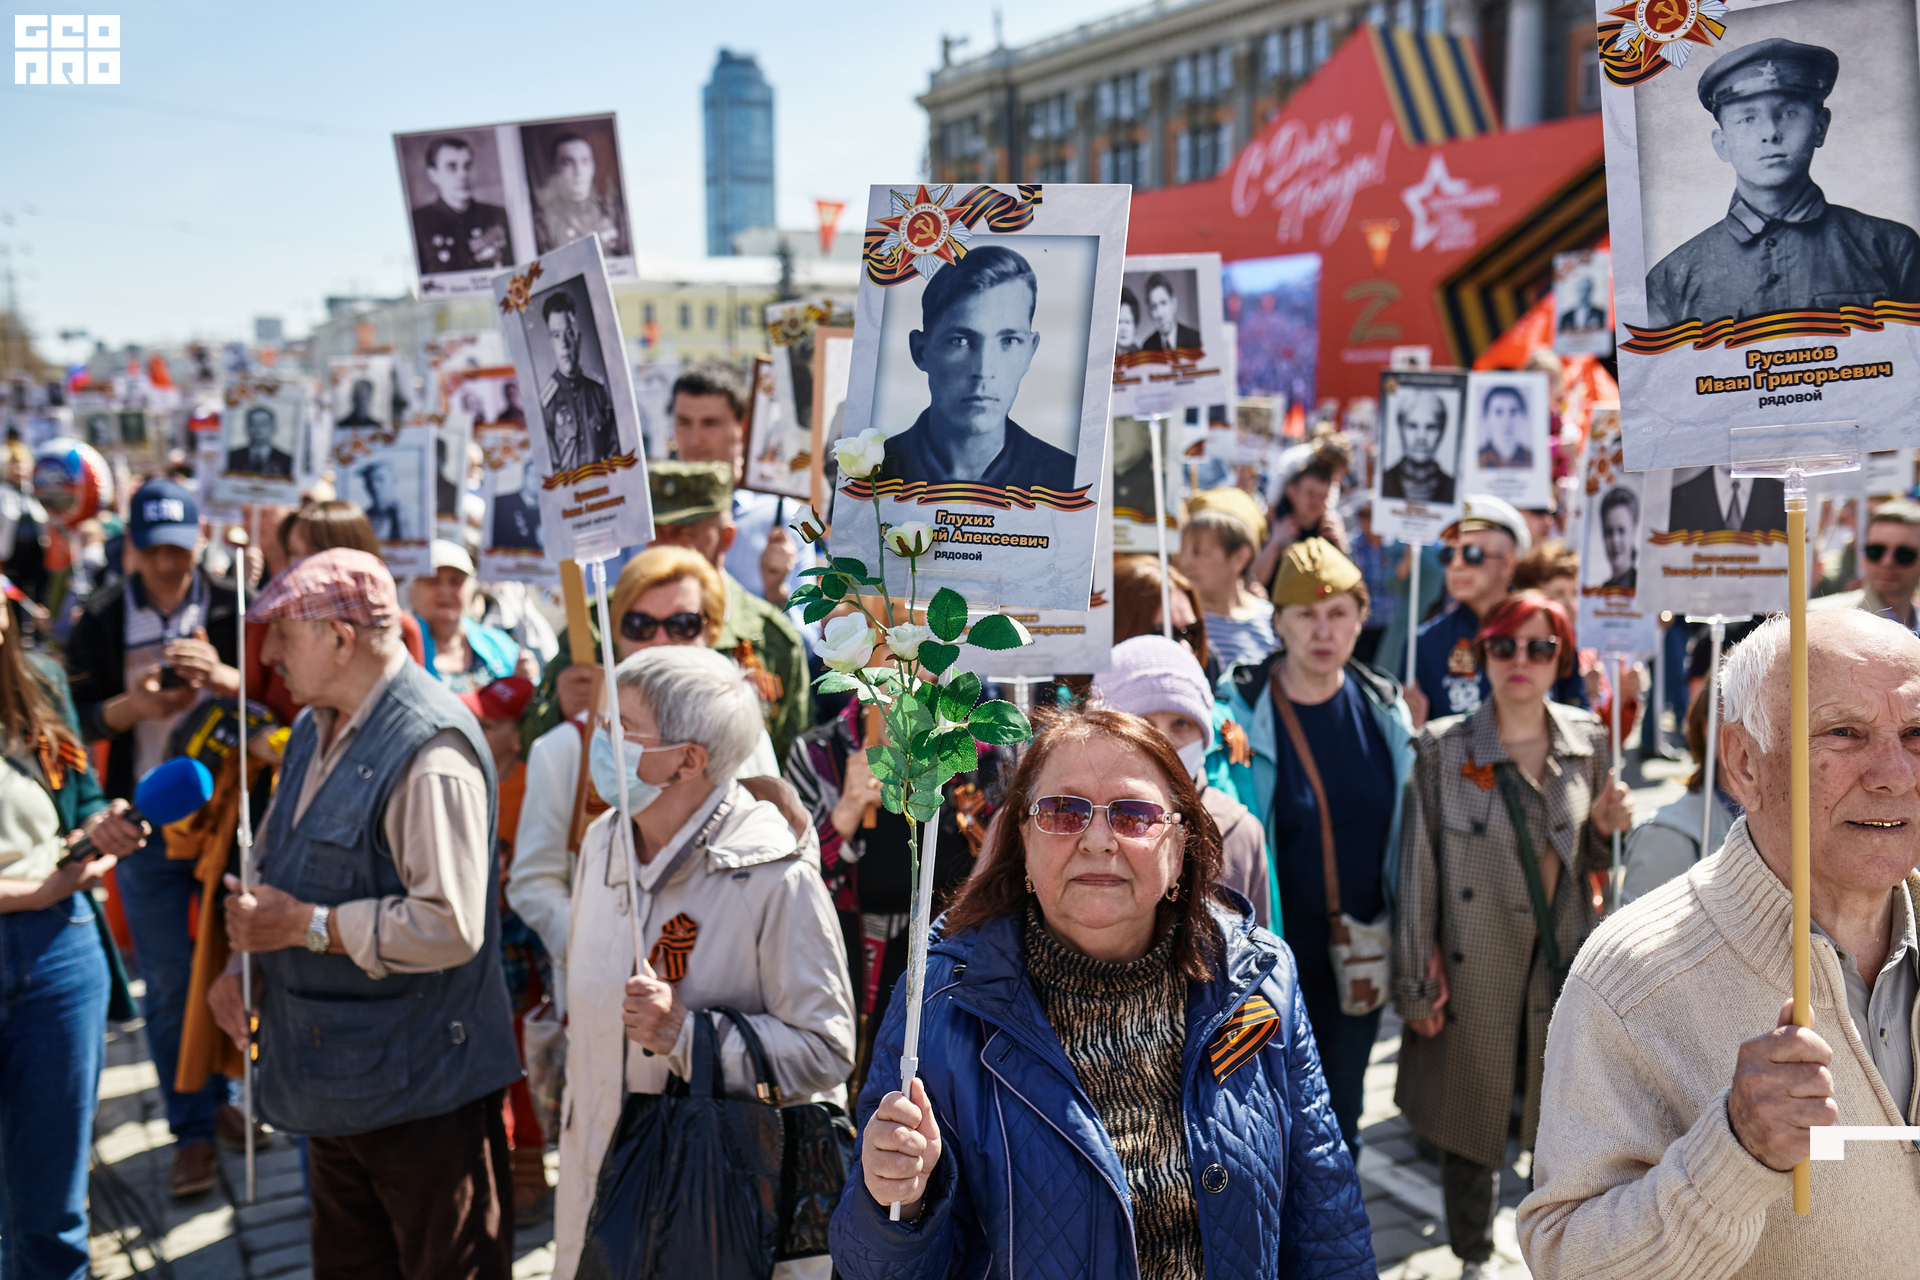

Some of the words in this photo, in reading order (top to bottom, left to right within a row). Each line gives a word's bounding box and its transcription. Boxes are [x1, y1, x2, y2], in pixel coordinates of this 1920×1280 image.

[901, 205, 944, 251] ОТЕЧЕСТВЕННАЯ
[1746, 346, 1838, 370] Русинов
[1696, 375, 1751, 395] Иван
[1754, 361, 1893, 391] Григорьевич
[1758, 389, 1823, 408] рядовой
[935, 509, 995, 528] Глухих
[951, 529, 1050, 549] Алексеевич
[934, 549, 983, 561] рядовой
